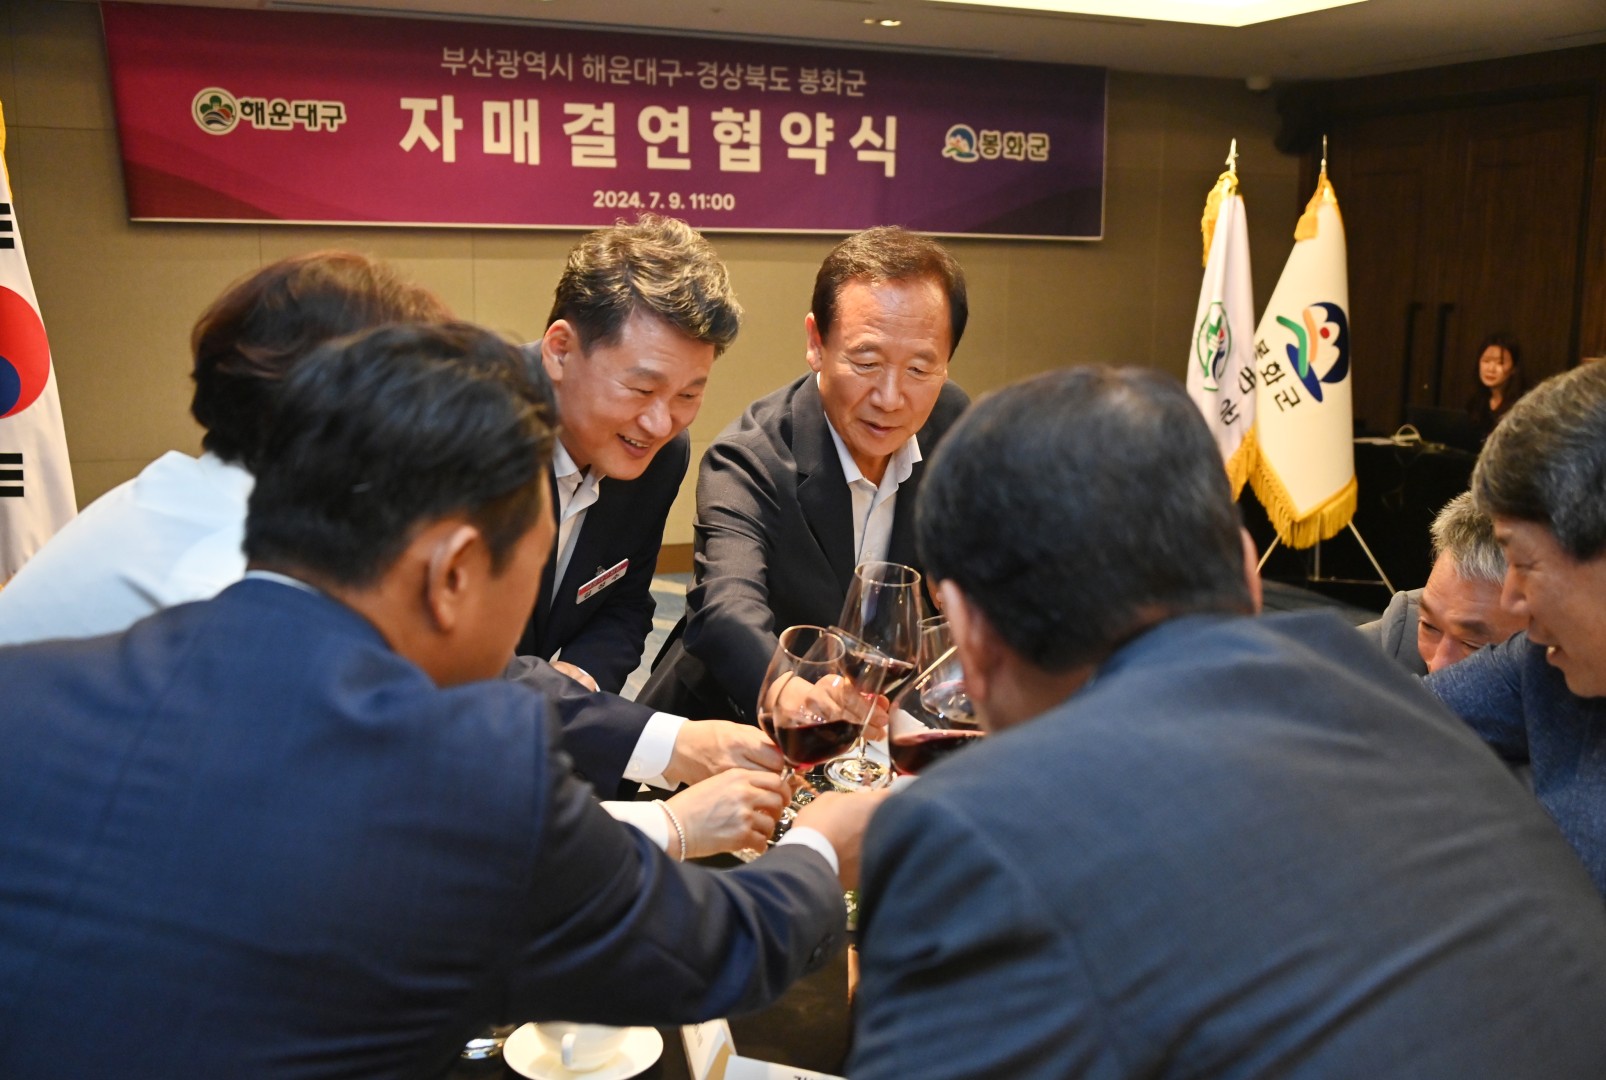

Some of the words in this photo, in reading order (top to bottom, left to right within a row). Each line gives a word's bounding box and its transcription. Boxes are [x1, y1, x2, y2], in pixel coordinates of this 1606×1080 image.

[440, 47, 573, 82] 부산광역시
[798, 66, 867, 97] 봉화군
[239, 99, 344, 128] 해운대구
[982, 133, 1047, 158] 봉화군
[593, 190, 645, 209] 2024.
[649, 191, 665, 209] 7.
[668, 192, 685, 210] 9.
[689, 193, 735, 211] 11:00
